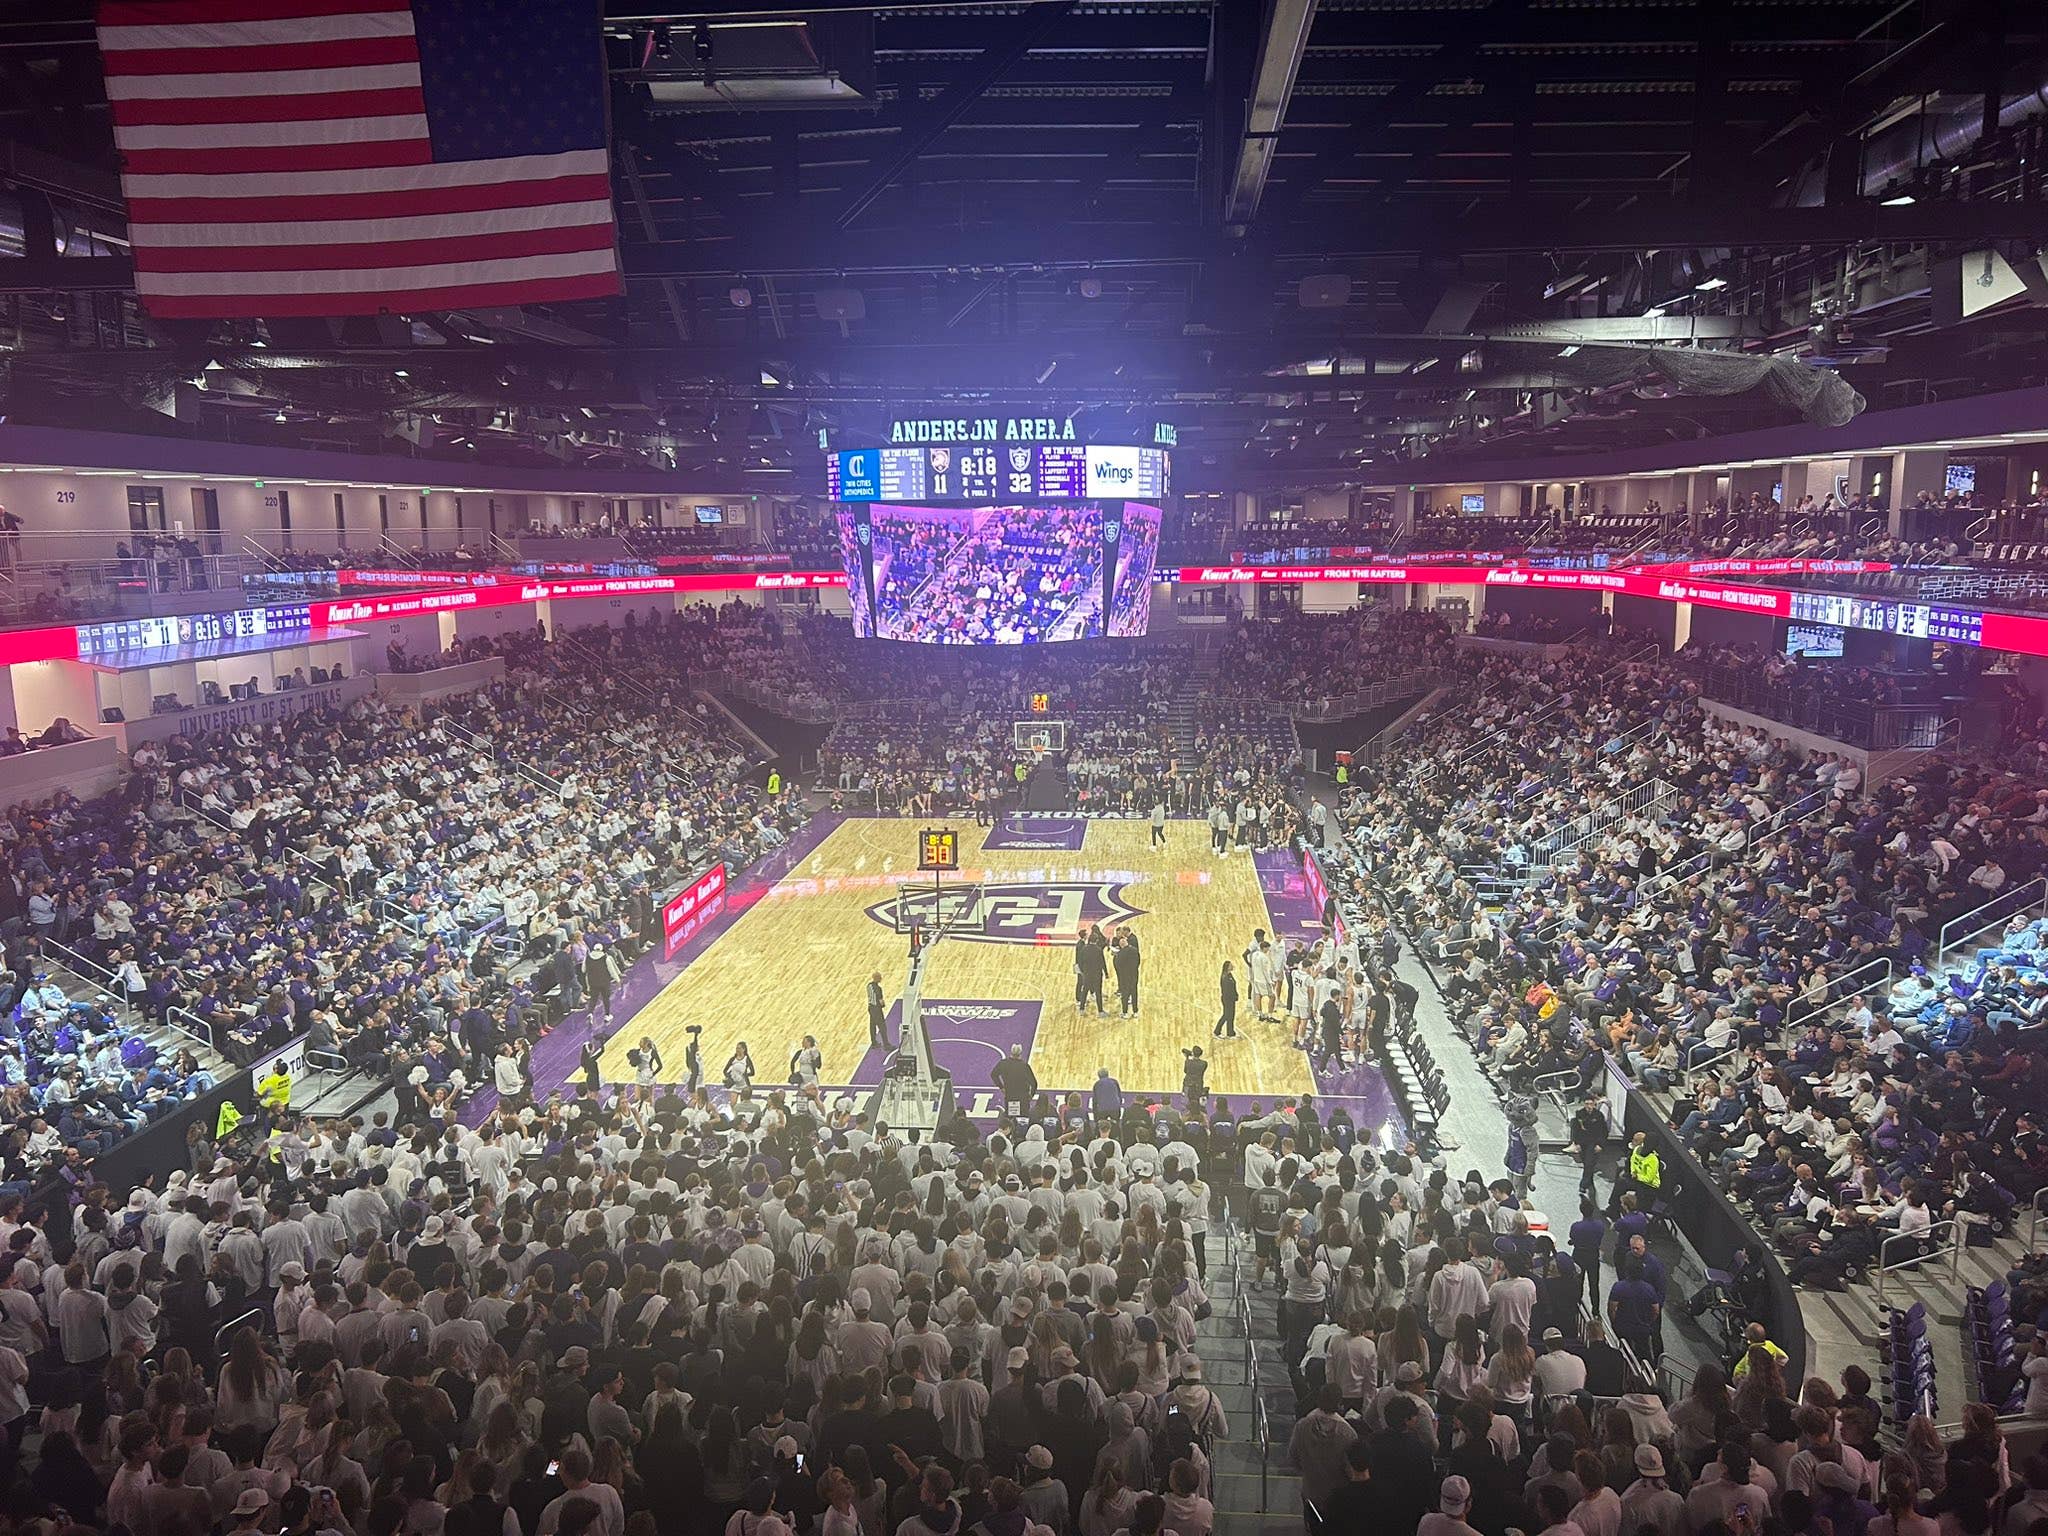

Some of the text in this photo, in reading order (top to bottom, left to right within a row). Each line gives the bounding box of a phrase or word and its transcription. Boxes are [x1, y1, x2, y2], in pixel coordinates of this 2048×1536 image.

[891, 419, 998, 442] ANDERSON
[960, 456, 997, 476] 8:18
[1095, 462, 1133, 484] Wings
[933, 473, 948, 495] 11
[1008, 472, 1032, 493] 32
[56, 491, 76, 504] 219
[264, 497, 278, 507] 220
[1324, 569, 1350, 579] FROM
[1352, 570, 1369, 579] THE
[1370, 570, 1406, 579] RAFTERS
[1580, 575, 1601, 585] FROM
[606, 581, 625, 591] FROM
[627, 580, 640, 590] THE
[641, 579, 675, 589] RAFTERS
[422, 597, 440, 609] FROM
[450, 593, 477, 605] RAFTERS
[1837, 605, 1845, 625] 11
[1863, 607, 1884, 631] 8:18
[1902, 613, 1915, 634] 32
[160, 625, 171, 645] 11
[195, 619, 221, 641] 8:18
[241, 617, 254, 635] 32
[178, 688, 342, 738] UNIVERSITY OF ST. THOMAS
[1008, 810, 1144, 819] THOMAS
[926, 845, 950, 864] 30
[1294, 977, 1303, 988] 24
[1358, 992, 1363, 1001] 4
